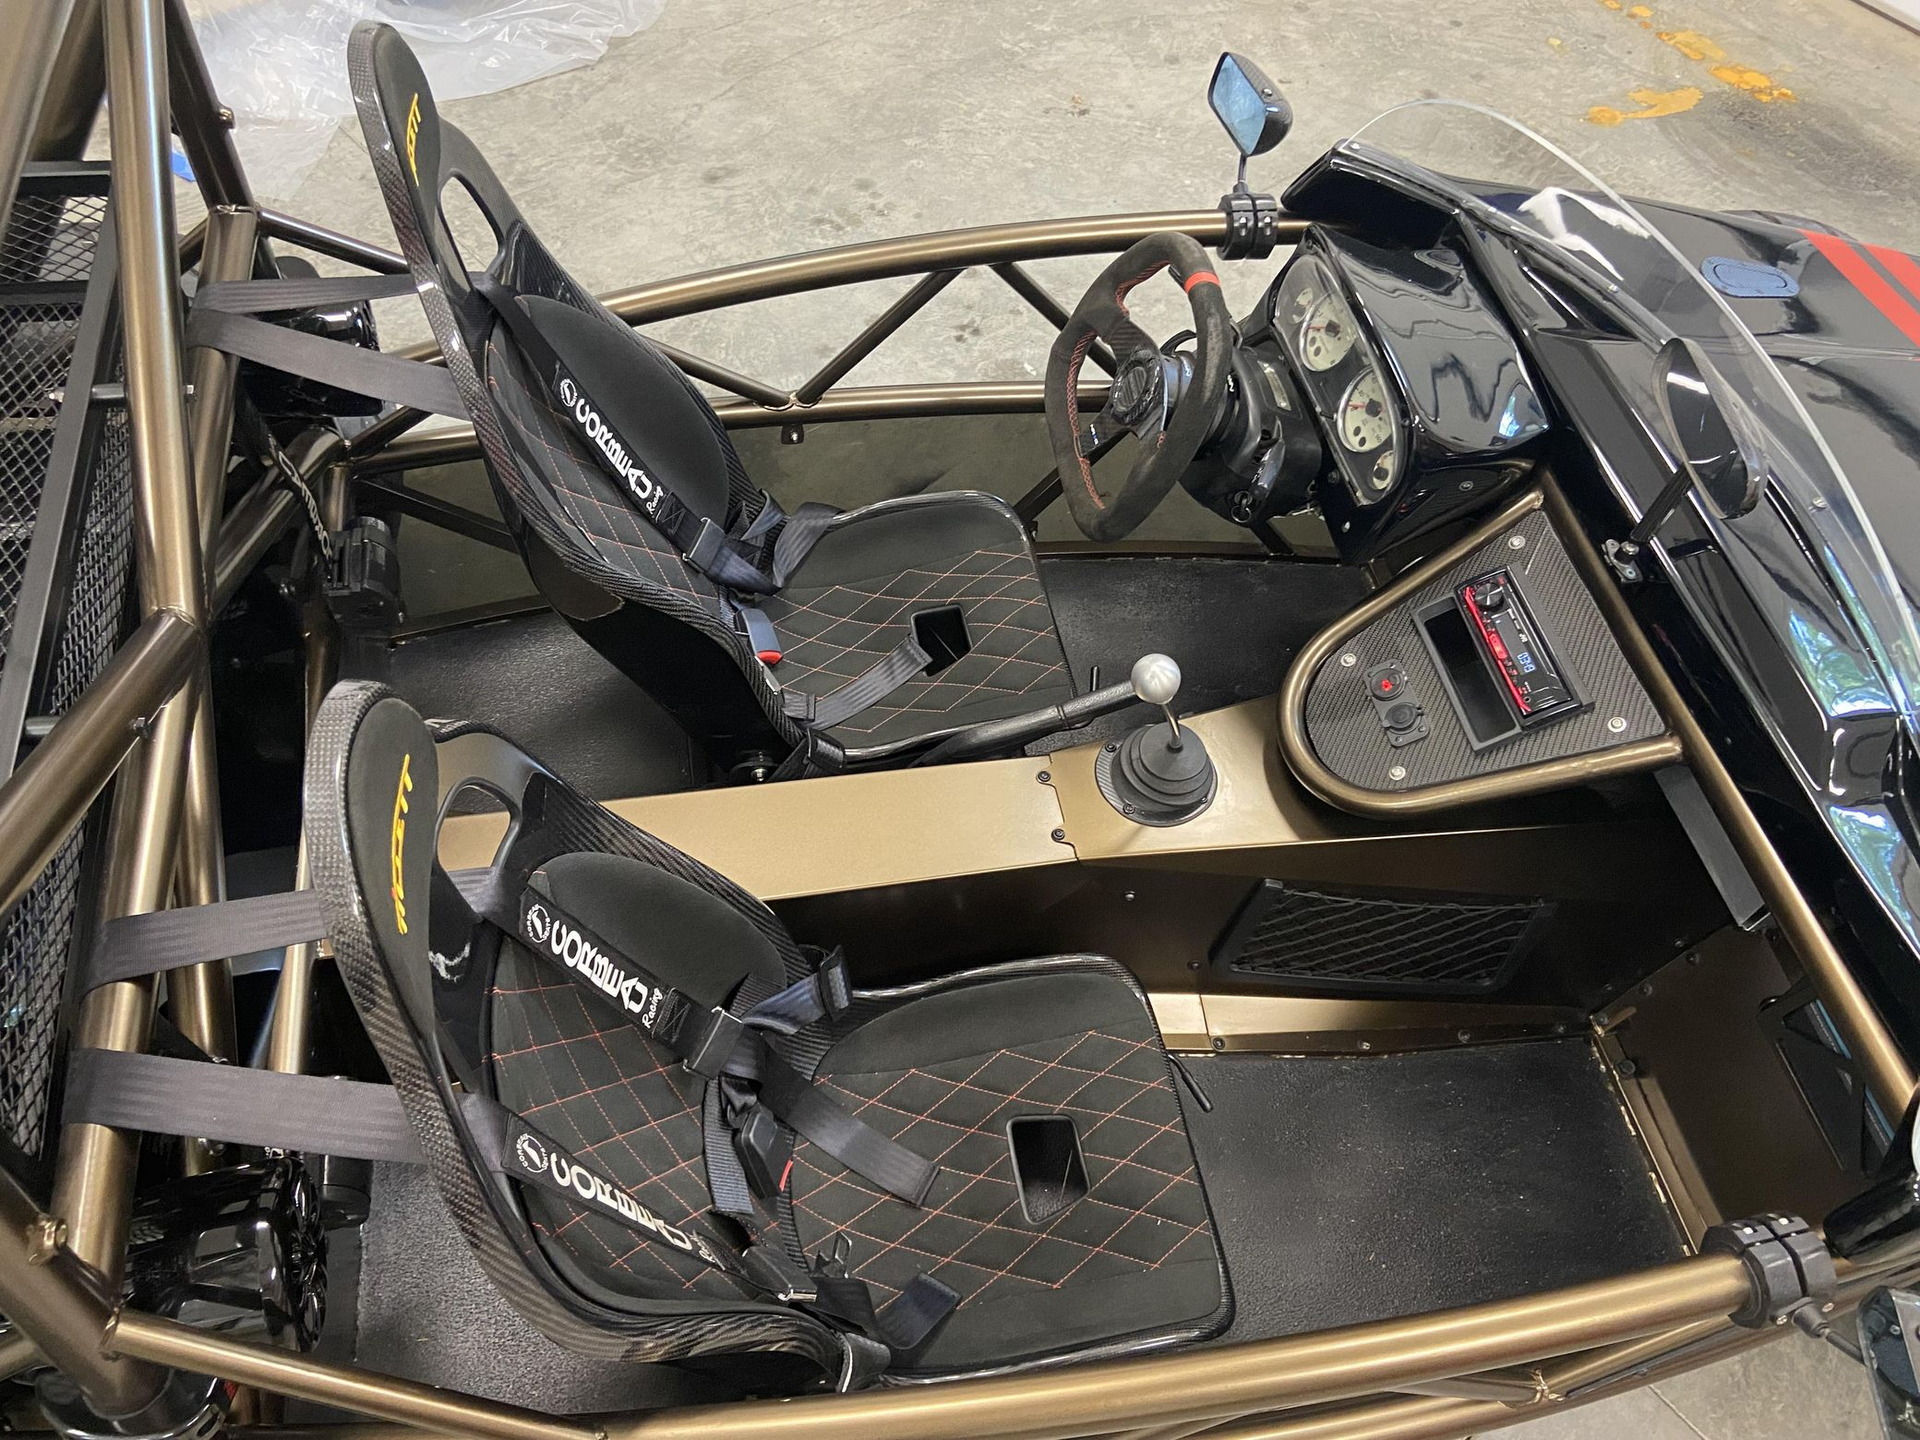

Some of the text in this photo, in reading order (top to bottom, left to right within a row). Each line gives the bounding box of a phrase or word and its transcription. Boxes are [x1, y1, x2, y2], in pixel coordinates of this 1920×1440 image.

[576, 398, 652, 499] CORBEAU
[646, 486, 664, 514] Racing
[551, 920, 648, 1013] CORBEAU
[642, 987, 663, 1028] Racing
[551, 1152, 692, 1250] CORBEAU
